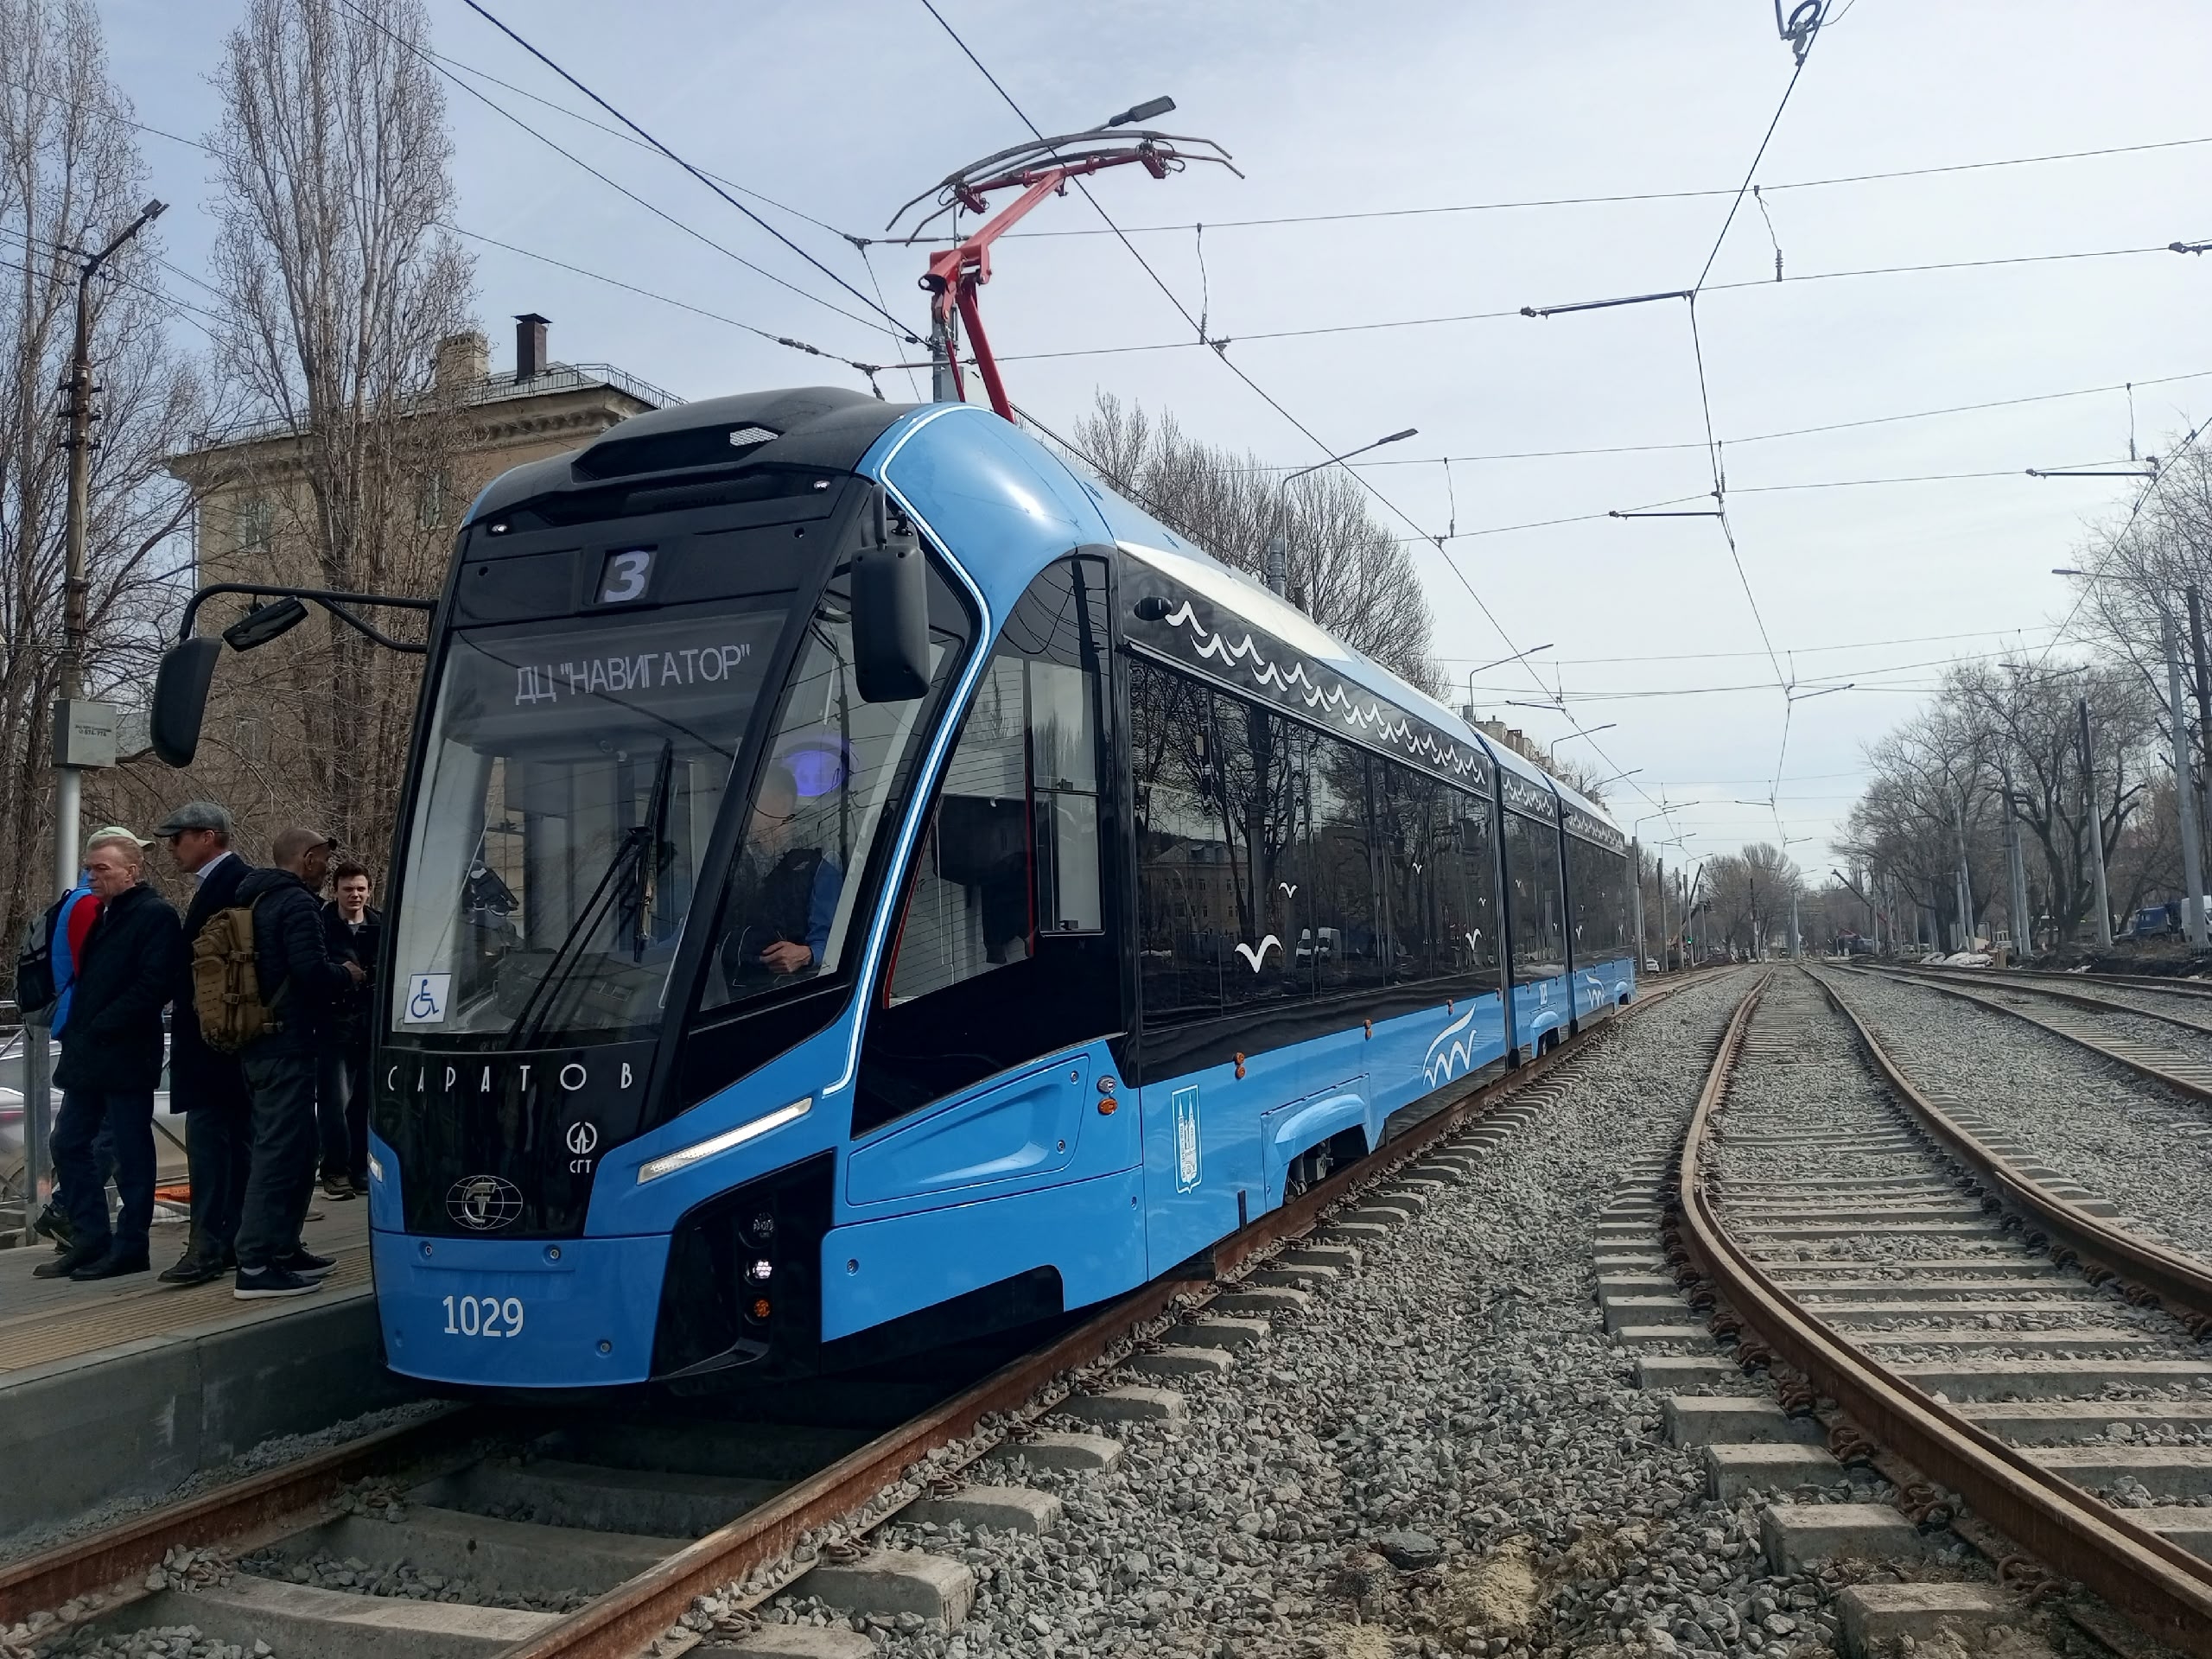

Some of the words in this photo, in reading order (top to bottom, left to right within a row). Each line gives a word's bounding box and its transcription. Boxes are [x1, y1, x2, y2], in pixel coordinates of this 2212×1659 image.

[605, 550, 650, 602] 3
[515, 664, 557, 706] ДЦ
[560, 643, 751, 696] "НАВИГАТОР"
[387, 1062, 633, 1093] САРАТОВ
[569, 1159, 593, 1173] СГТ
[442, 1295, 524, 1338] 1029
